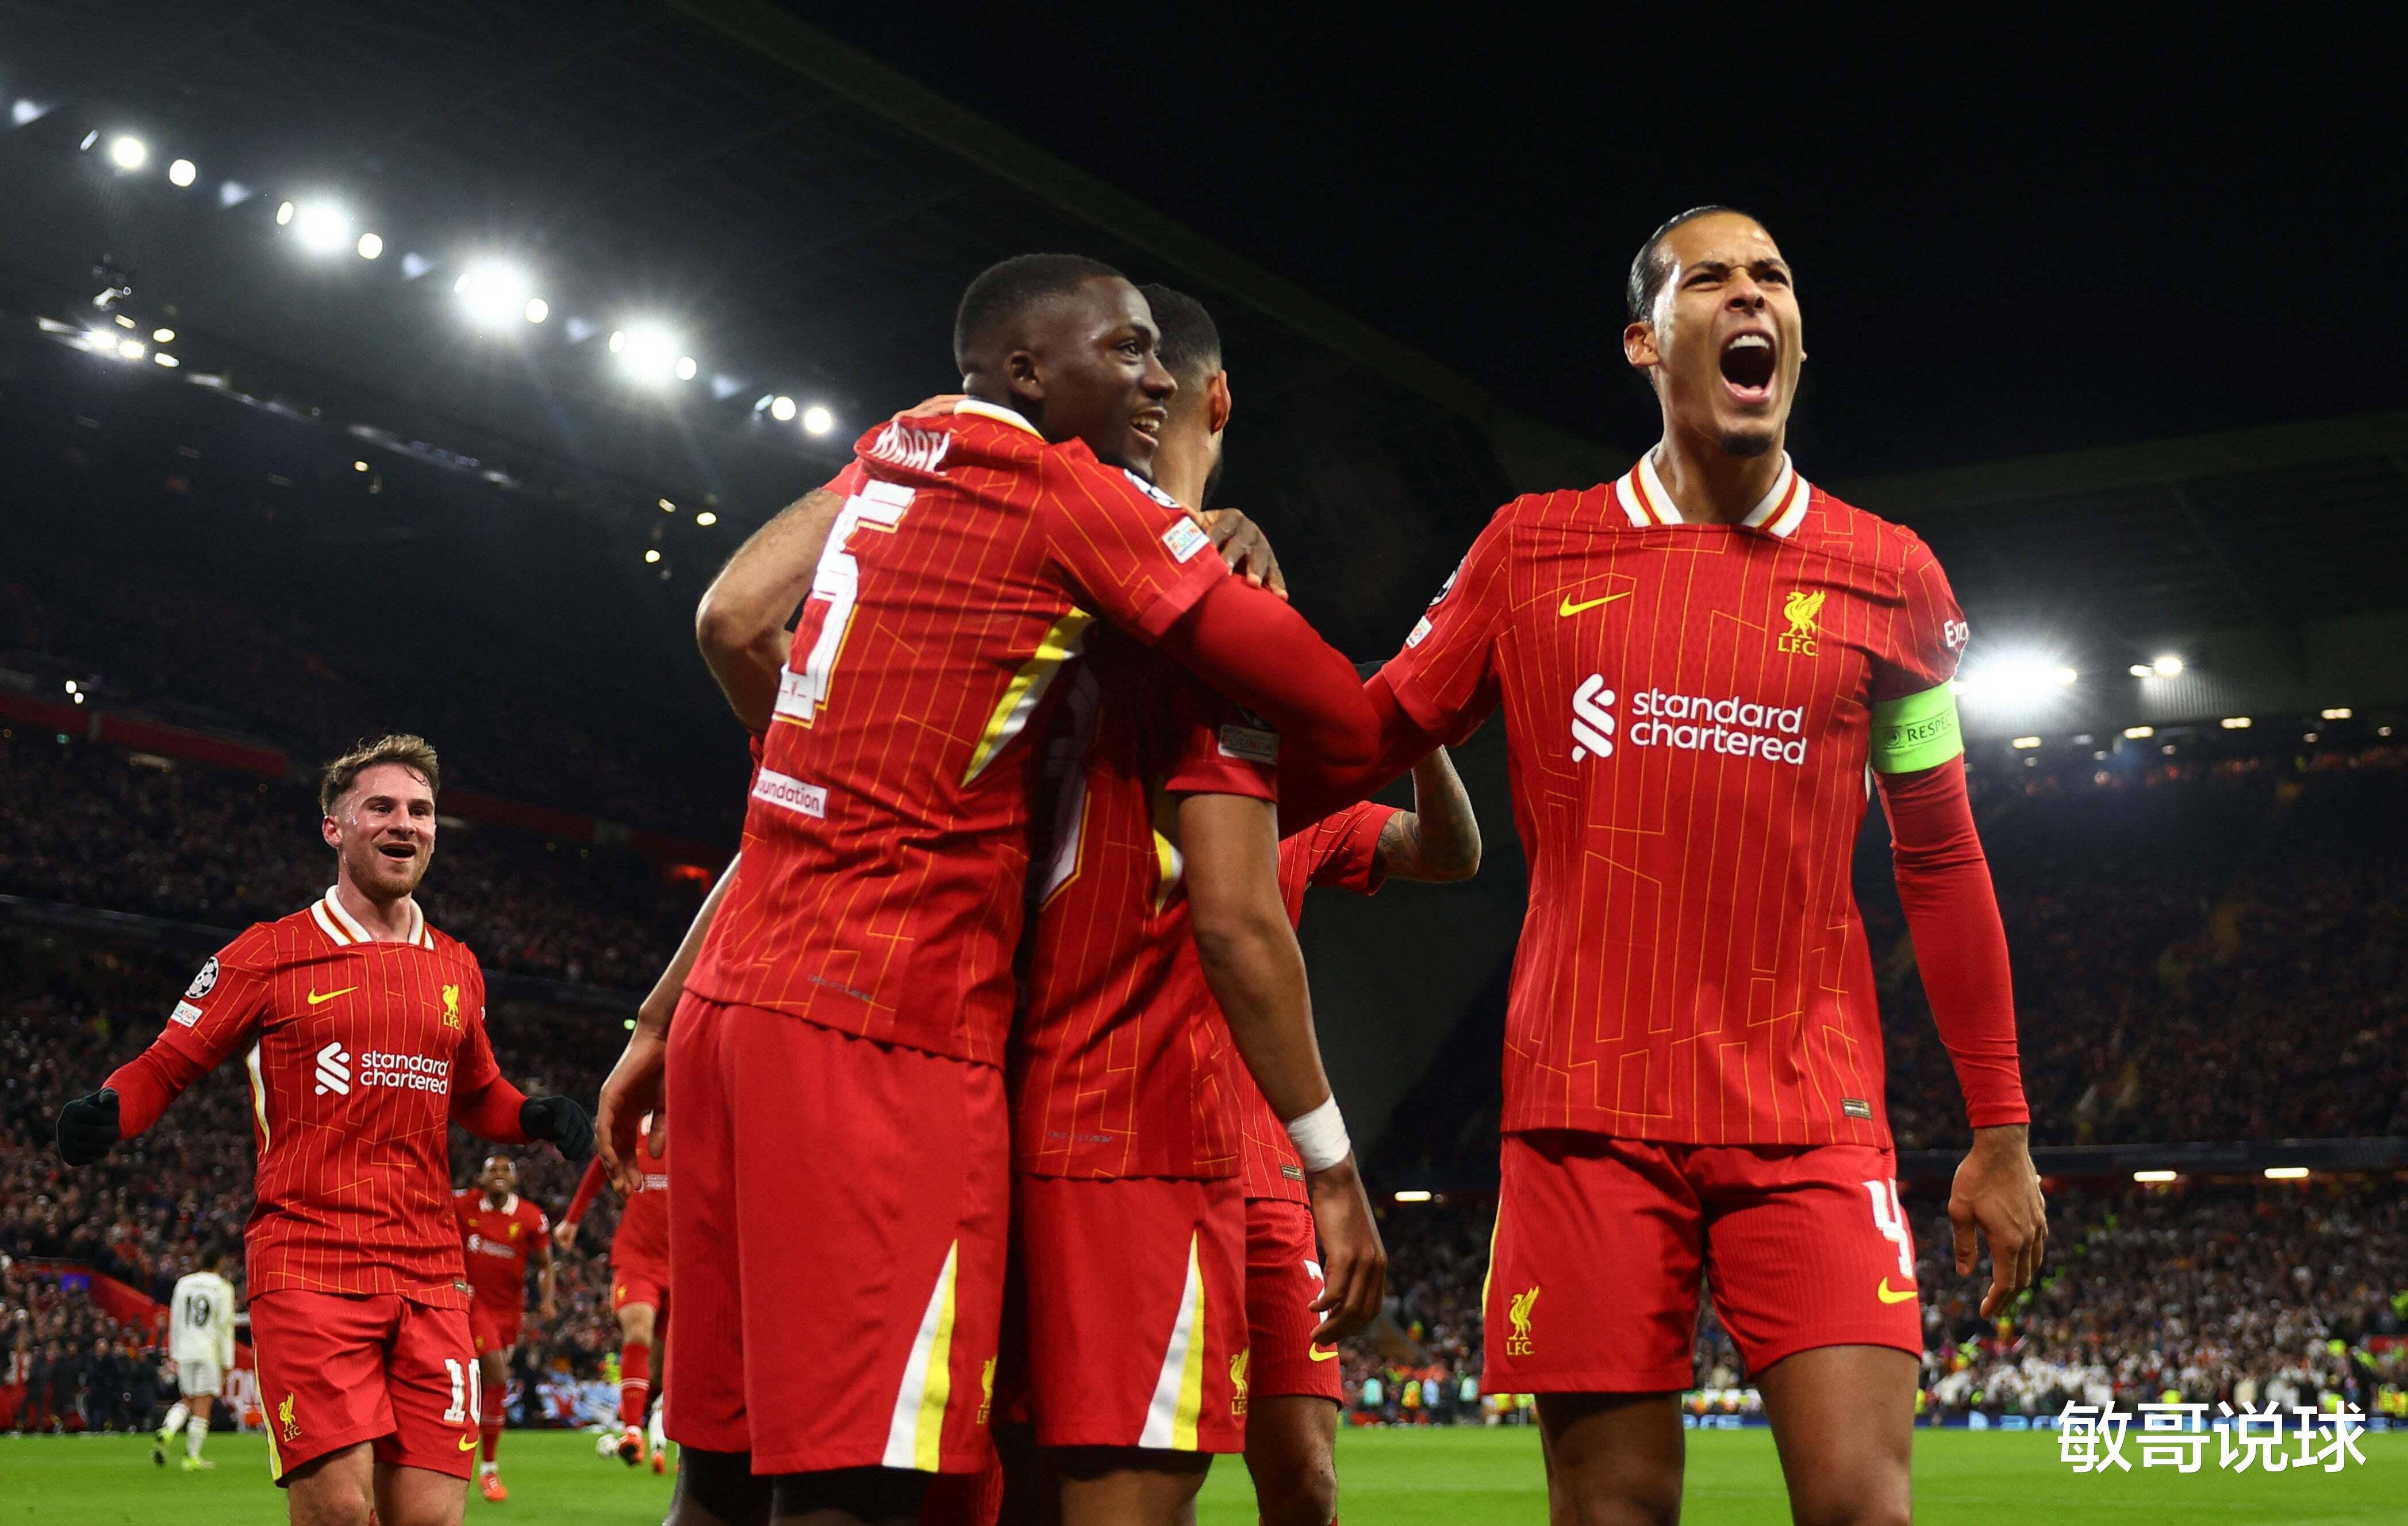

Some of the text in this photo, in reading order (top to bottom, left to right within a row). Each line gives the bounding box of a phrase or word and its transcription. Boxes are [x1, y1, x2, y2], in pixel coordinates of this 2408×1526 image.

[774, 480, 915, 723] 5
[1632, 688, 1804, 734] standard
[1630, 718, 1807, 765] chartered
[360, 1068, 448, 1095] chartered
[361, 1050, 450, 1076] standard
[1861, 1178, 1914, 1280] 4
[185, 1294, 209, 1328] 19
[444, 1358, 481, 1424] 10
